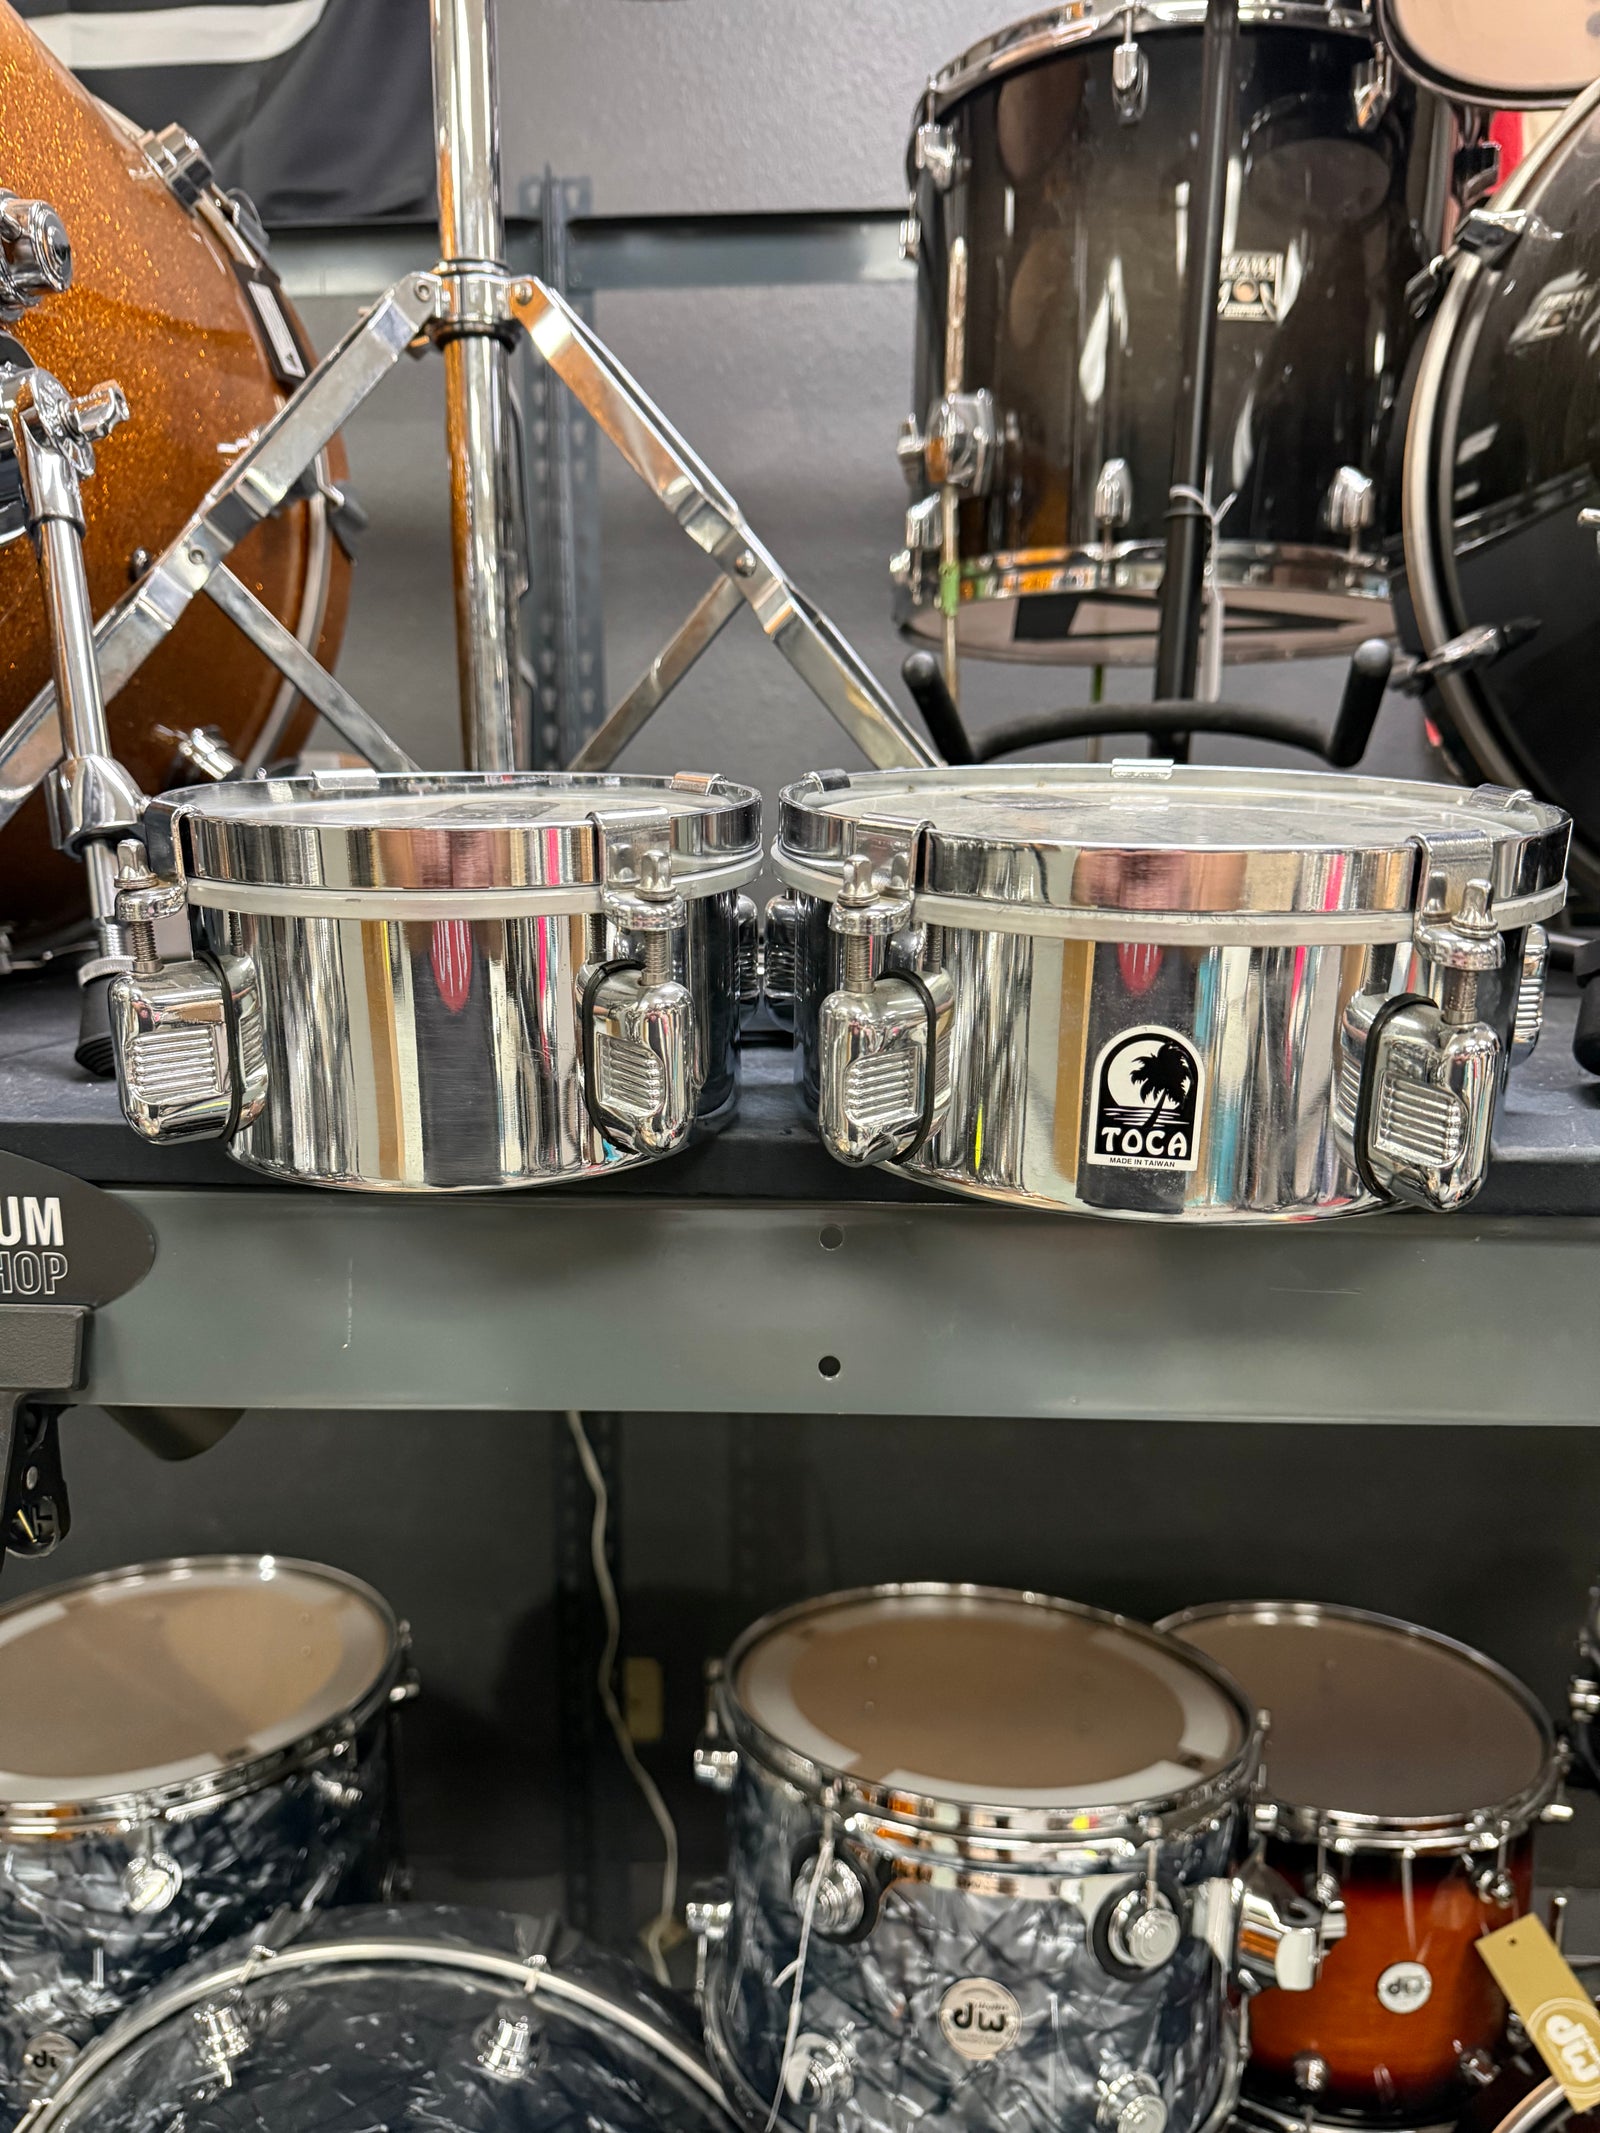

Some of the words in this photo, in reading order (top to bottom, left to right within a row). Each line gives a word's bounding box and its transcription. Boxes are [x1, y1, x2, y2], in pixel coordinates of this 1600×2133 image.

[1101, 1127, 1188, 1157] TOCA
[1109, 1157, 1133, 1165] MADE
[1144, 1160, 1176, 1168] TAIWAN
[953, 2001, 1006, 2032] dw
